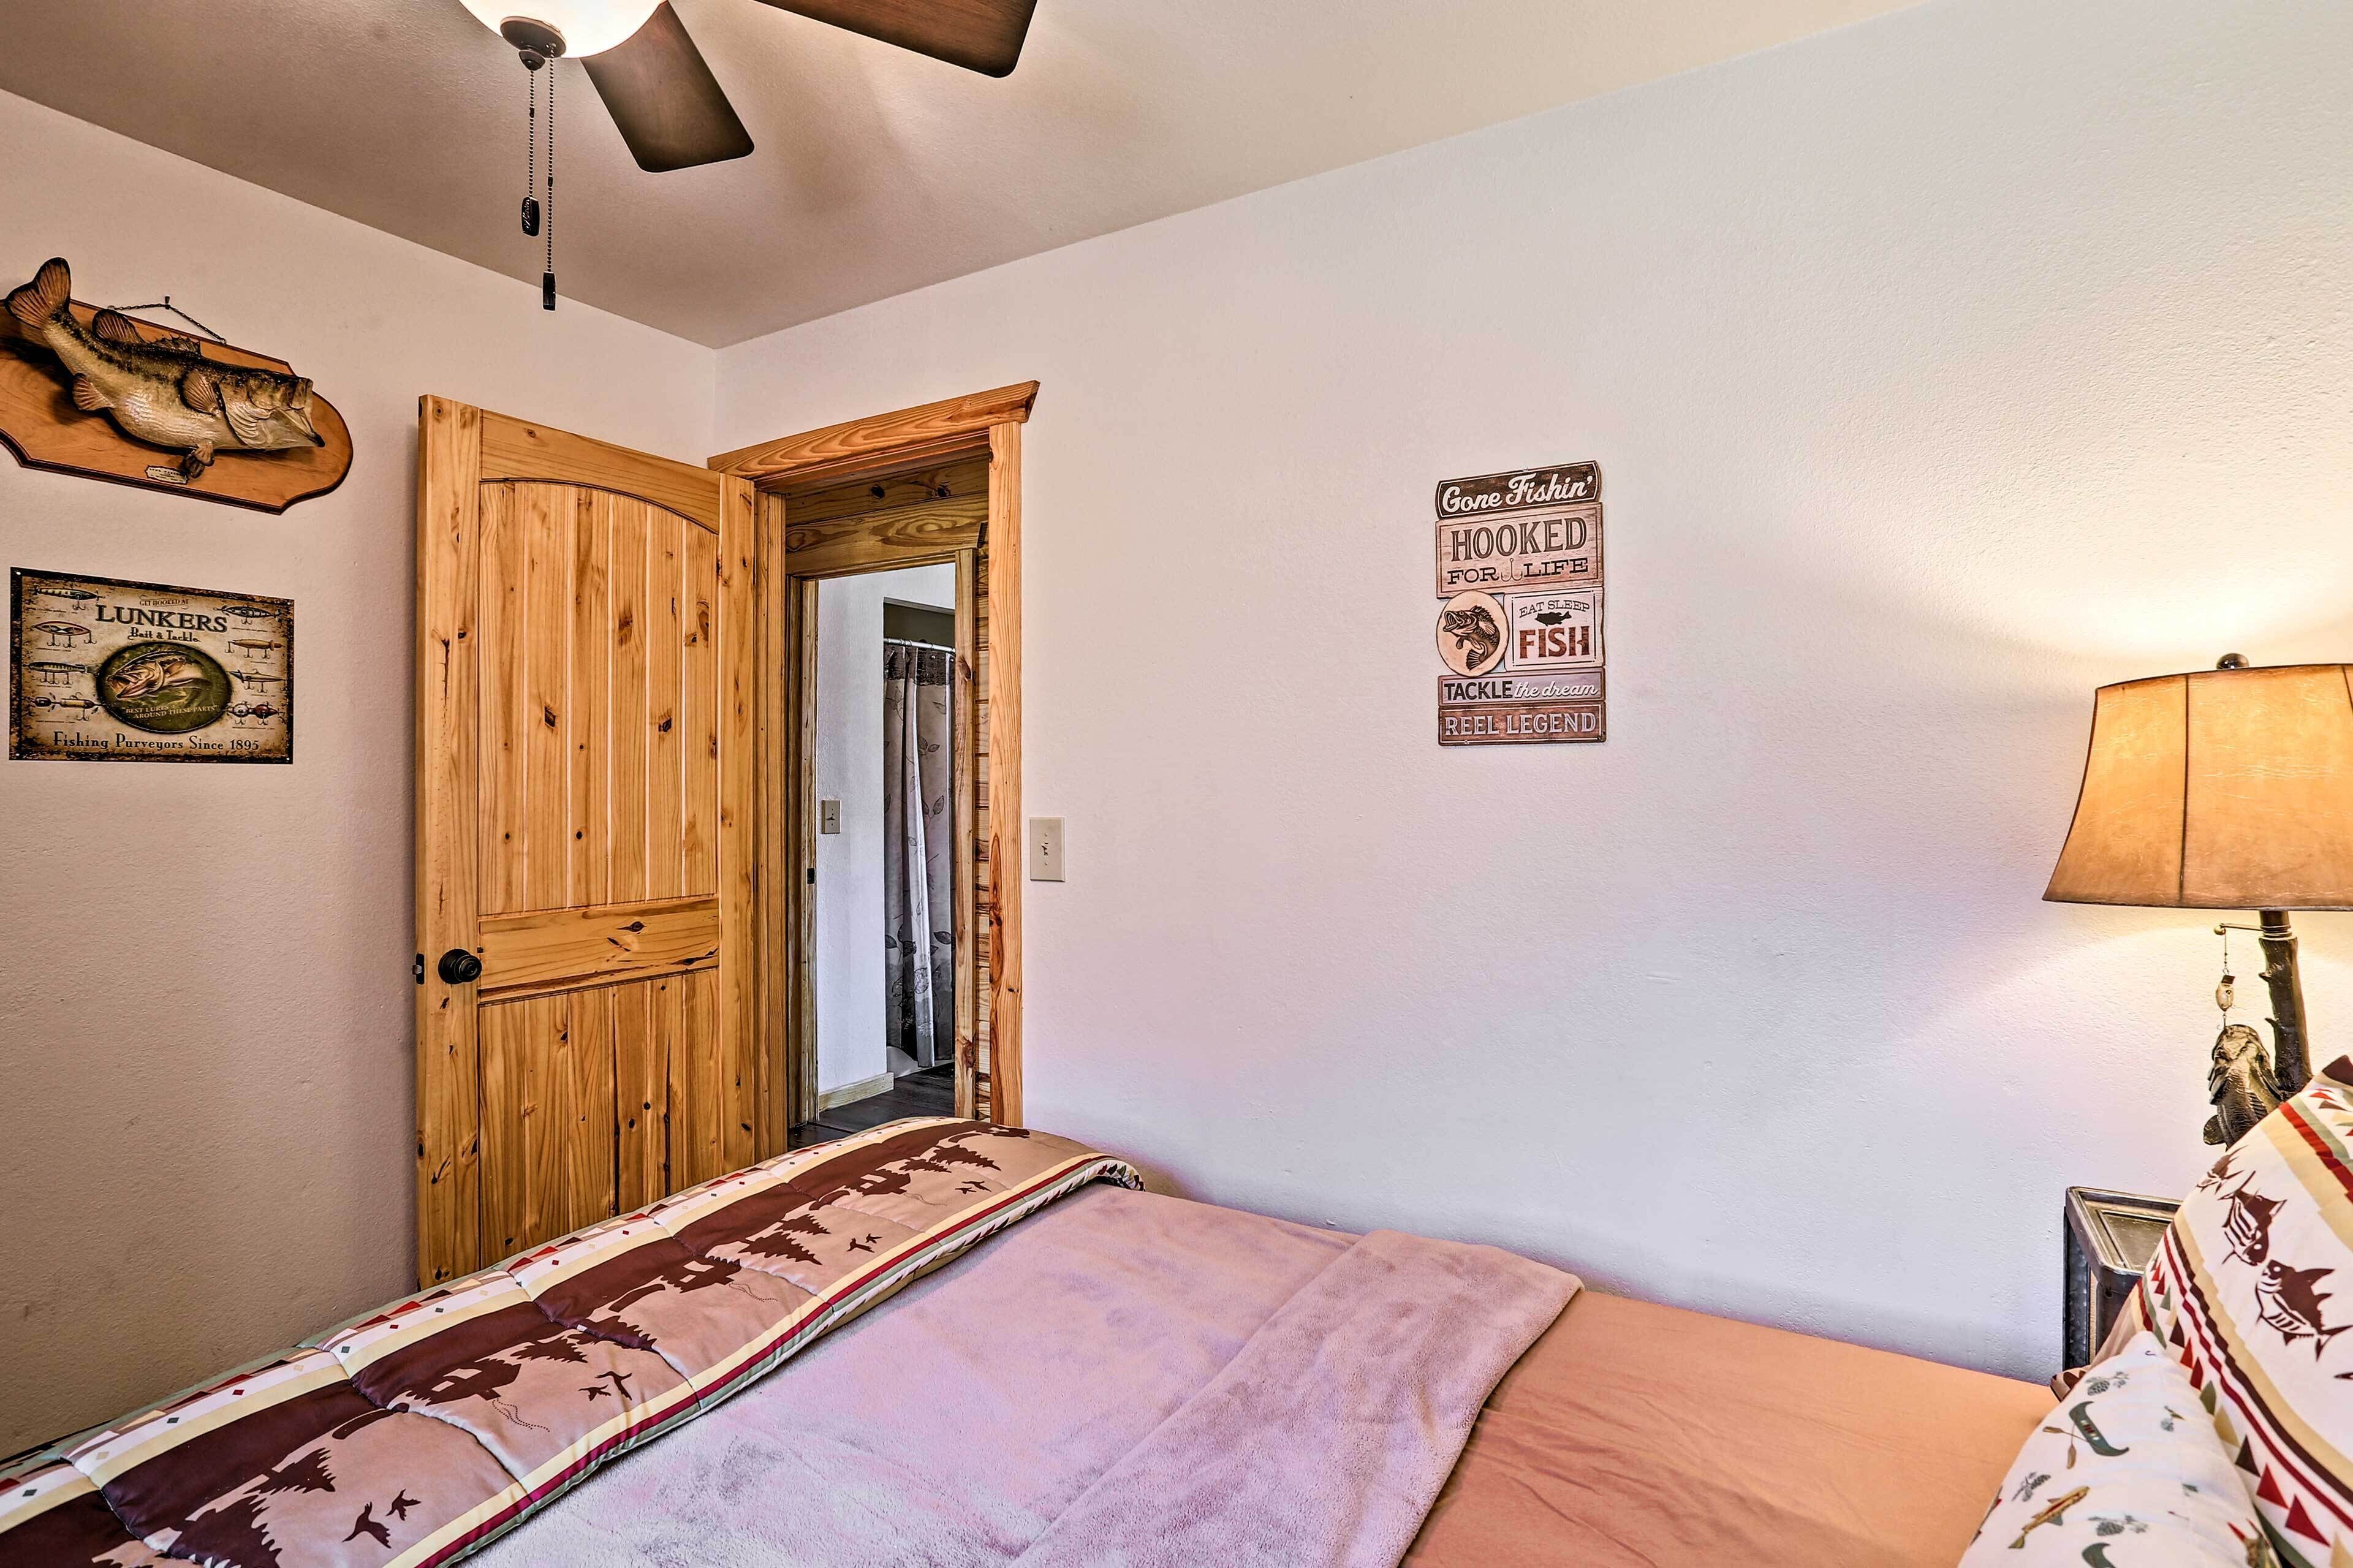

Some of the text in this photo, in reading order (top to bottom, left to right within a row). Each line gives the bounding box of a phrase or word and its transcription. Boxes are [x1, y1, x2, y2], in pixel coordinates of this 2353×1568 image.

[1442, 472, 1593, 513] Gone Fishin'
[1450, 517, 1588, 562] HOOKED
[1447, 558, 1589, 585] FOR LIFE
[95, 604, 228, 633] LUNKERS
[1519, 599, 1590, 618] EAT SLEEP
[127, 627, 153, 640] Bait
[166, 630, 201, 642] Tackle
[1519, 626, 1591, 659] FISH
[1444, 680, 1598, 701] TACKLE the dream
[1444, 711, 1597, 736] REEL LEGEND
[53, 730, 260, 751] Fishing Purveyors Since 1895
